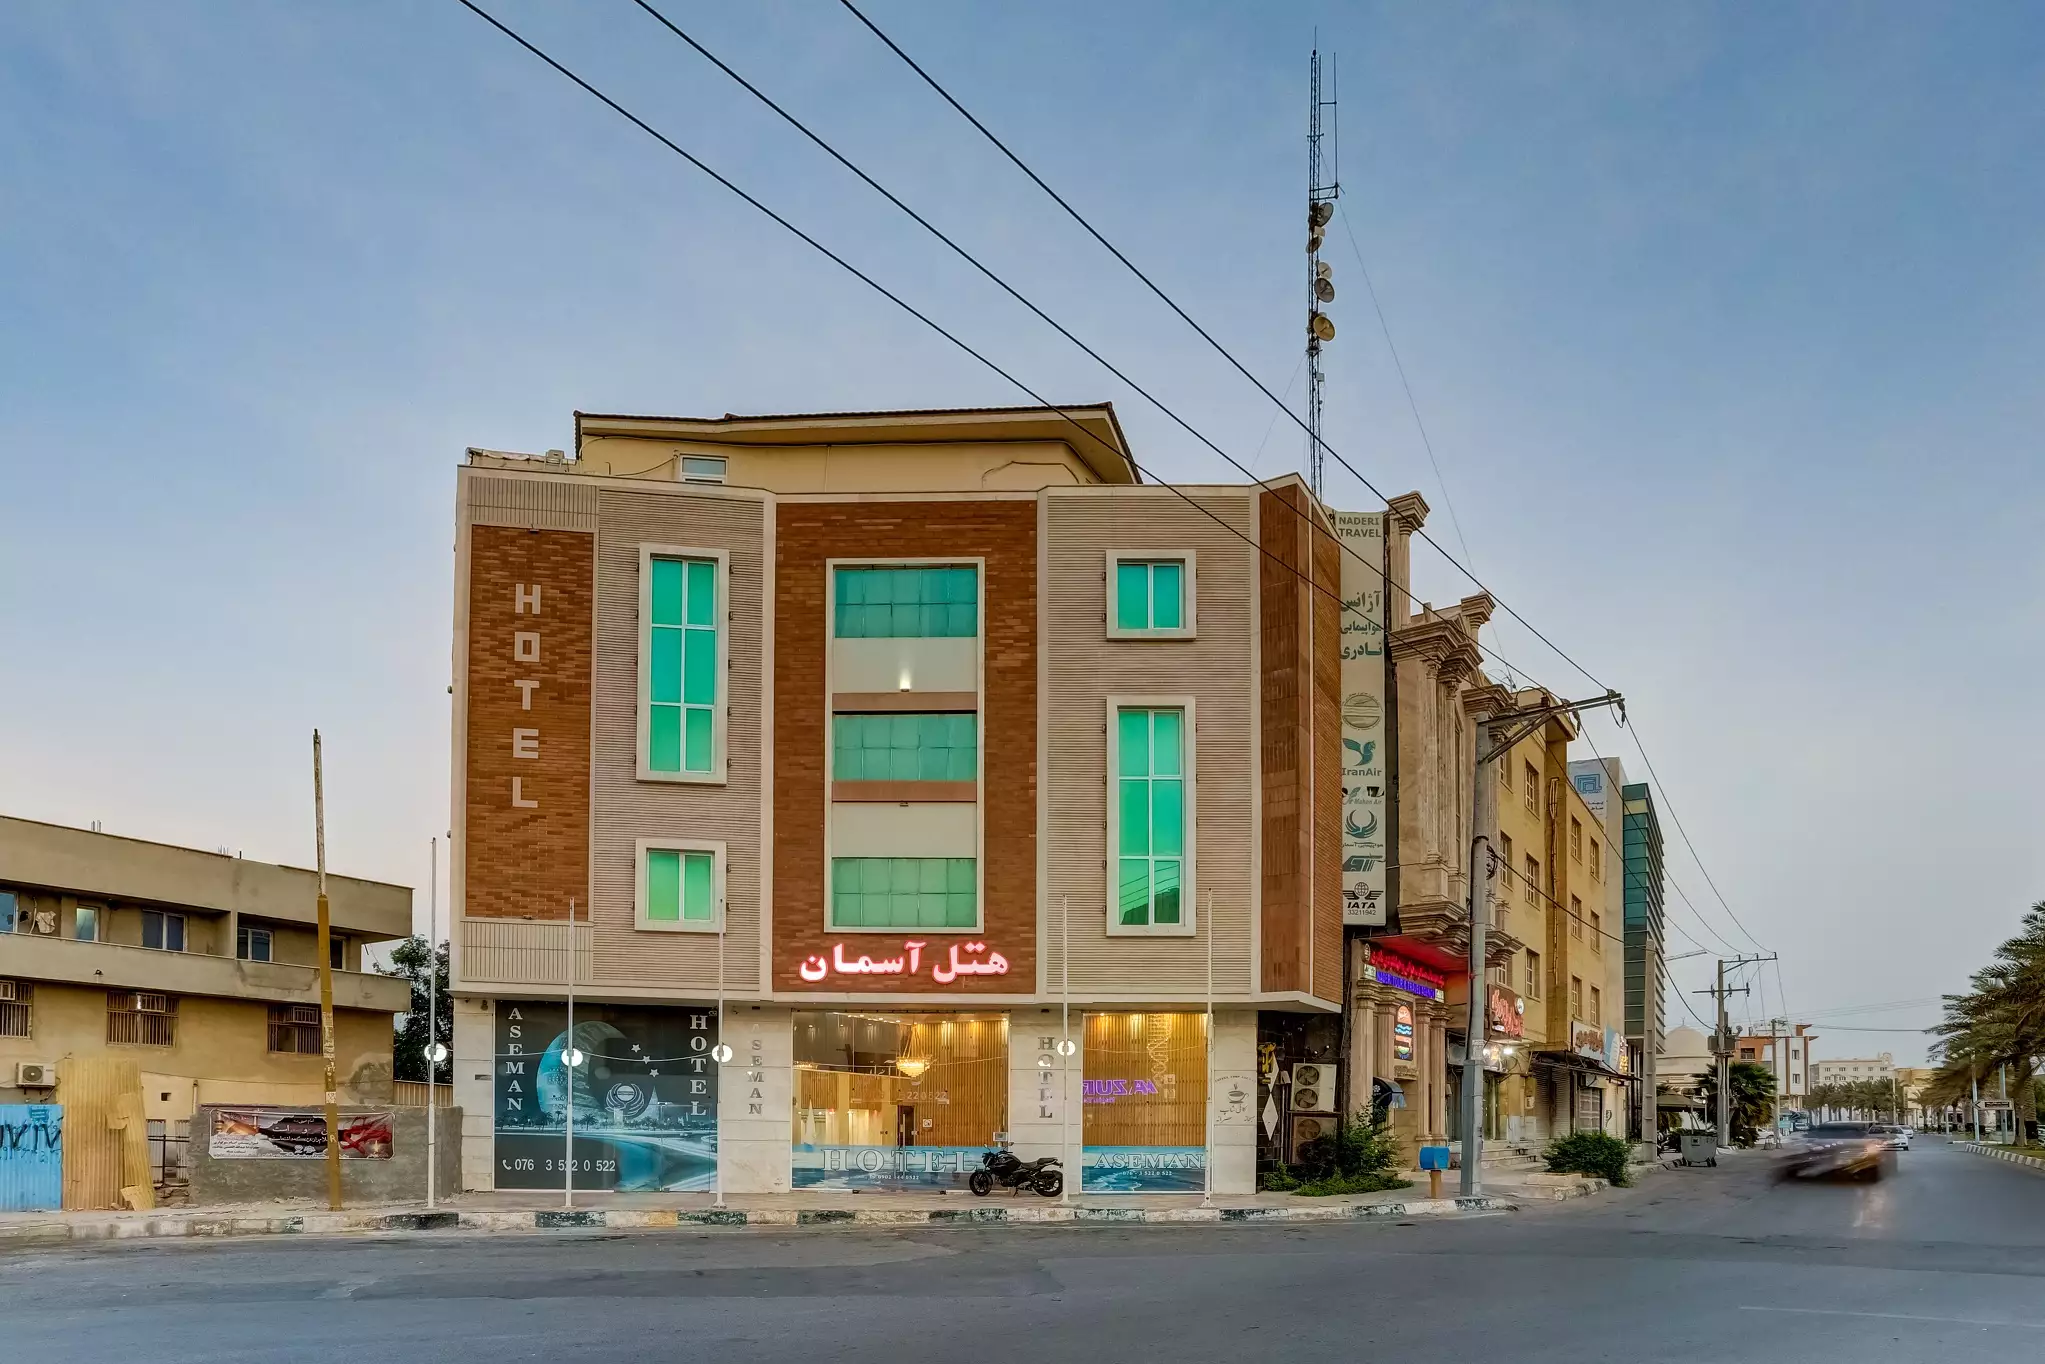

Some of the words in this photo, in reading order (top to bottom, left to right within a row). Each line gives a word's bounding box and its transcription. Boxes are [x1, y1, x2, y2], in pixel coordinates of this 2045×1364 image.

[1338, 516, 1380, 525] NADERI
[1338, 528, 1382, 538] TRAVEL
[1340, 590, 1382, 613] آژانس
[1340, 642, 1383, 660] نادری
[511, 583, 542, 809] HOTEL
[1342, 767, 1382, 777] IranAir
[1347, 901, 1376, 909] IATA
[799, 940, 928, 983] آسمان
[932, 940, 1010, 984] هتل
[505, 1007, 525, 1111] ASEMAN
[689, 1014, 708, 1117] HOTEL
[1037, 1036, 1055, 1119] HOTEL
[514, 1158, 535, 1172] 076
[545, 1158, 553, 1171] 3
[557, 1158, 578, 1172] 52
[583, 1159, 590, 1172] 0
[595, 1159, 616, 1172] 522
[821, 1148, 977, 1174] HOTEL
[1093, 1153, 1206, 1170] ASEMAN
